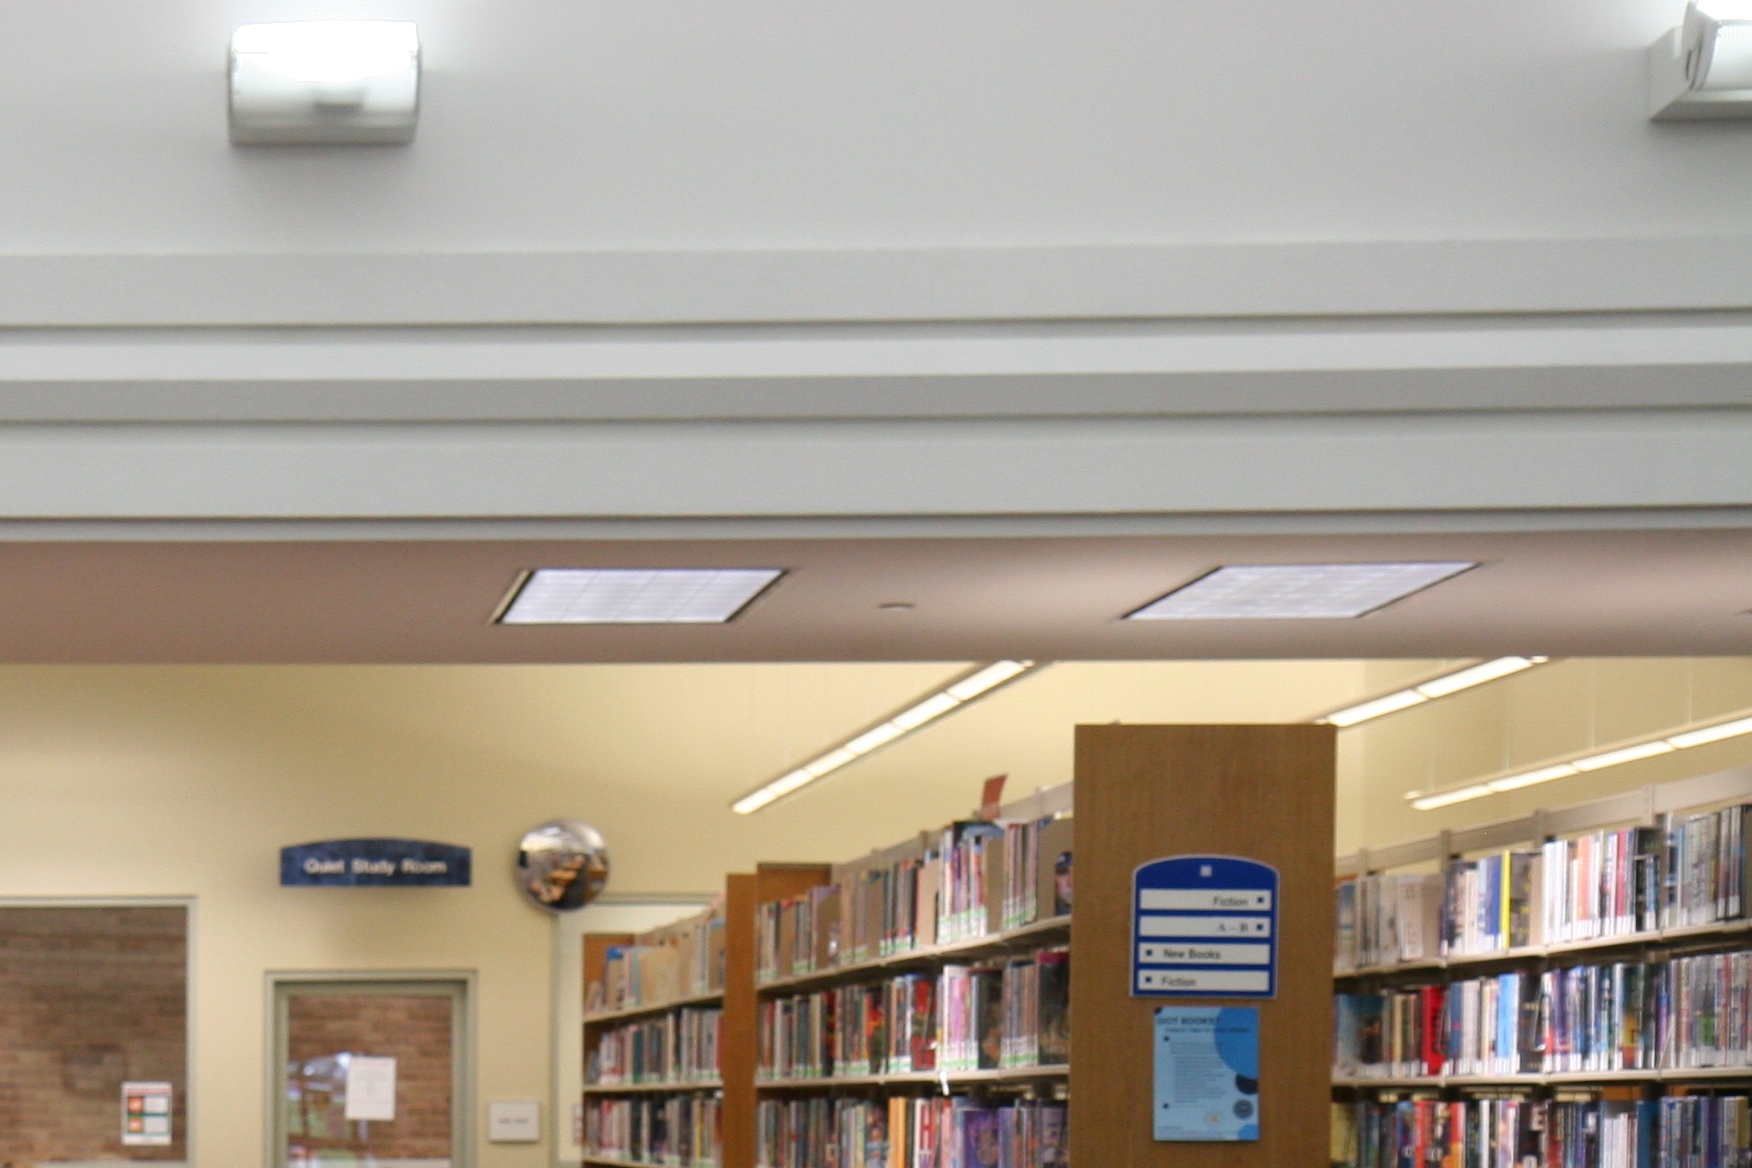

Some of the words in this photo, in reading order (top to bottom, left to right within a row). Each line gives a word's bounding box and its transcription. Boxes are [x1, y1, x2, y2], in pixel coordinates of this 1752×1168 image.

[303, 858, 345, 875] Quiet
[351, 858, 396, 877] Study
[402, 858, 447, 874] Room
[1212, 896, 1249, 907] Fiction
[1163, 949, 1185, 960] New
[1188, 949, 1222, 960] Books
[1161, 976, 1197, 987] Fiction
